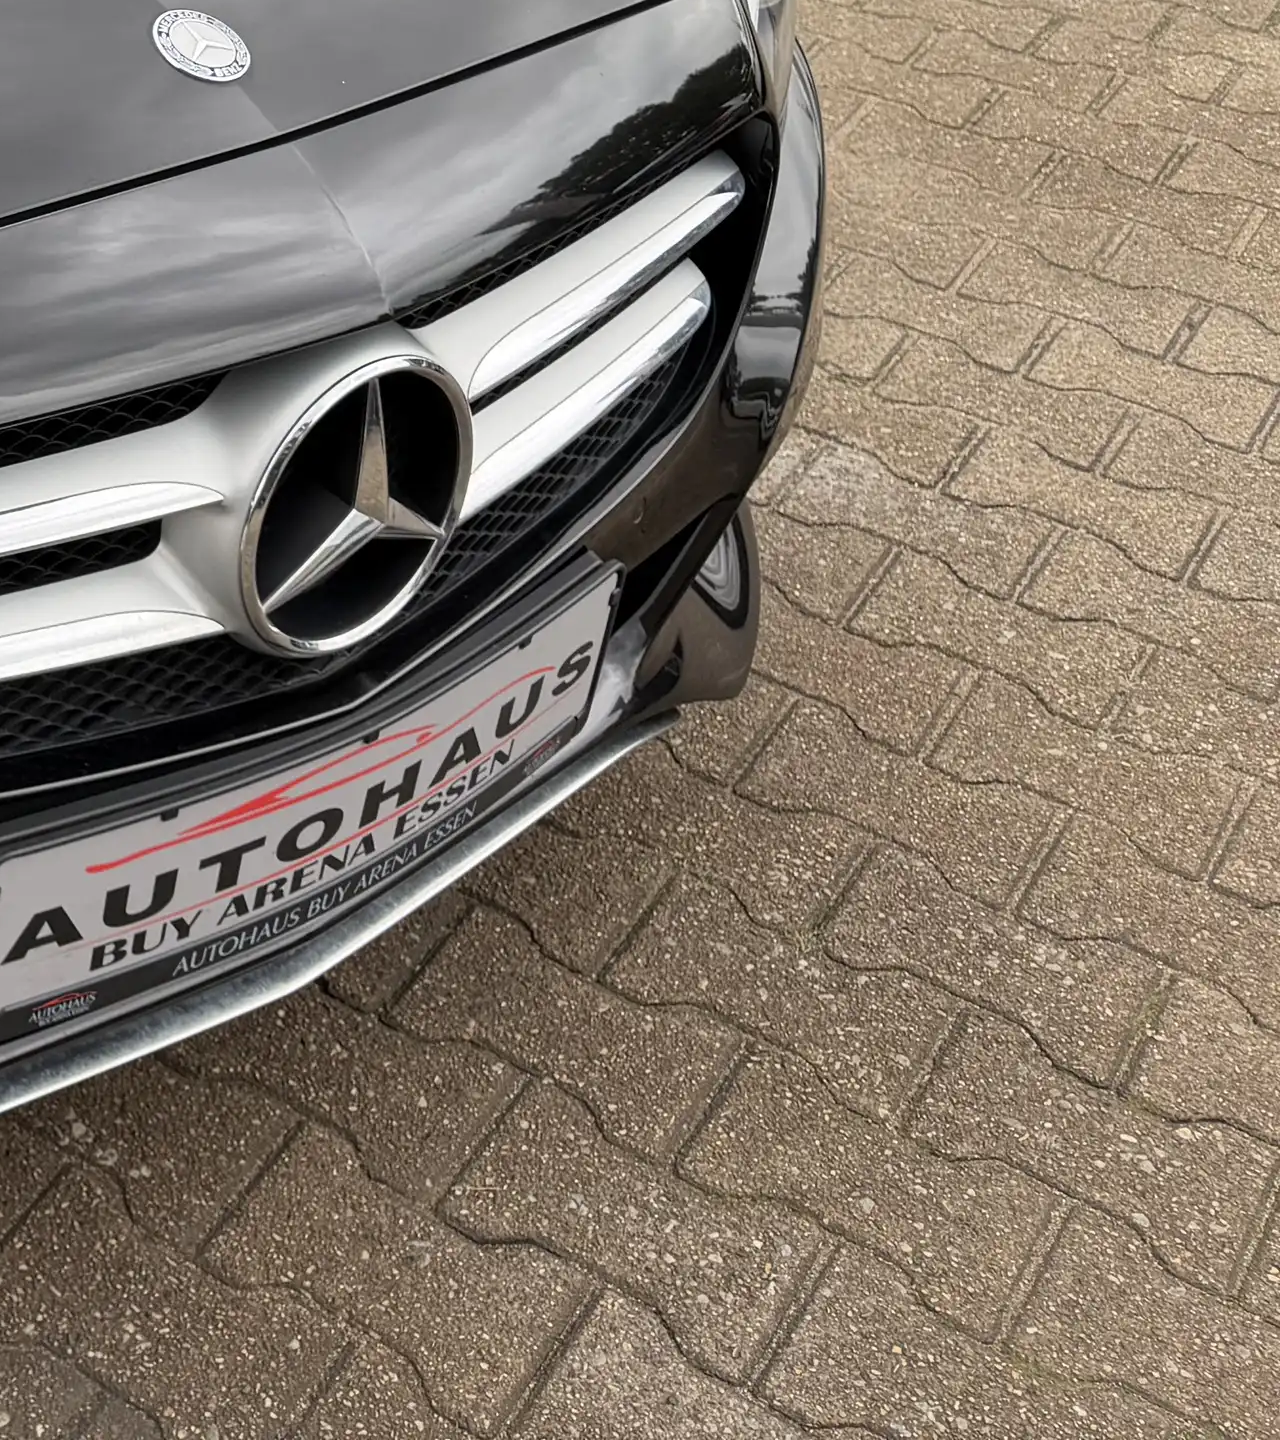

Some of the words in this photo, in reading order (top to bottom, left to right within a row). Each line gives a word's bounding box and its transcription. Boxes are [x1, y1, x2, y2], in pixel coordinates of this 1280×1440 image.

[214, 63, 244, 78] BENZ
[0, 641, 594, 966] AUTOHAUS
[89, 909, 203, 972] BUY
[217, 833, 377, 926] ARENA
[393, 738, 516, 840] ESSEN
[171, 911, 302, 978] AUTOHAUS
[306, 881, 351, 919] BUY
[353, 844, 418, 895] ARENA
[424, 800, 478, 850] ESSEN
[28, 993, 97, 1024] AUTOHAUS
